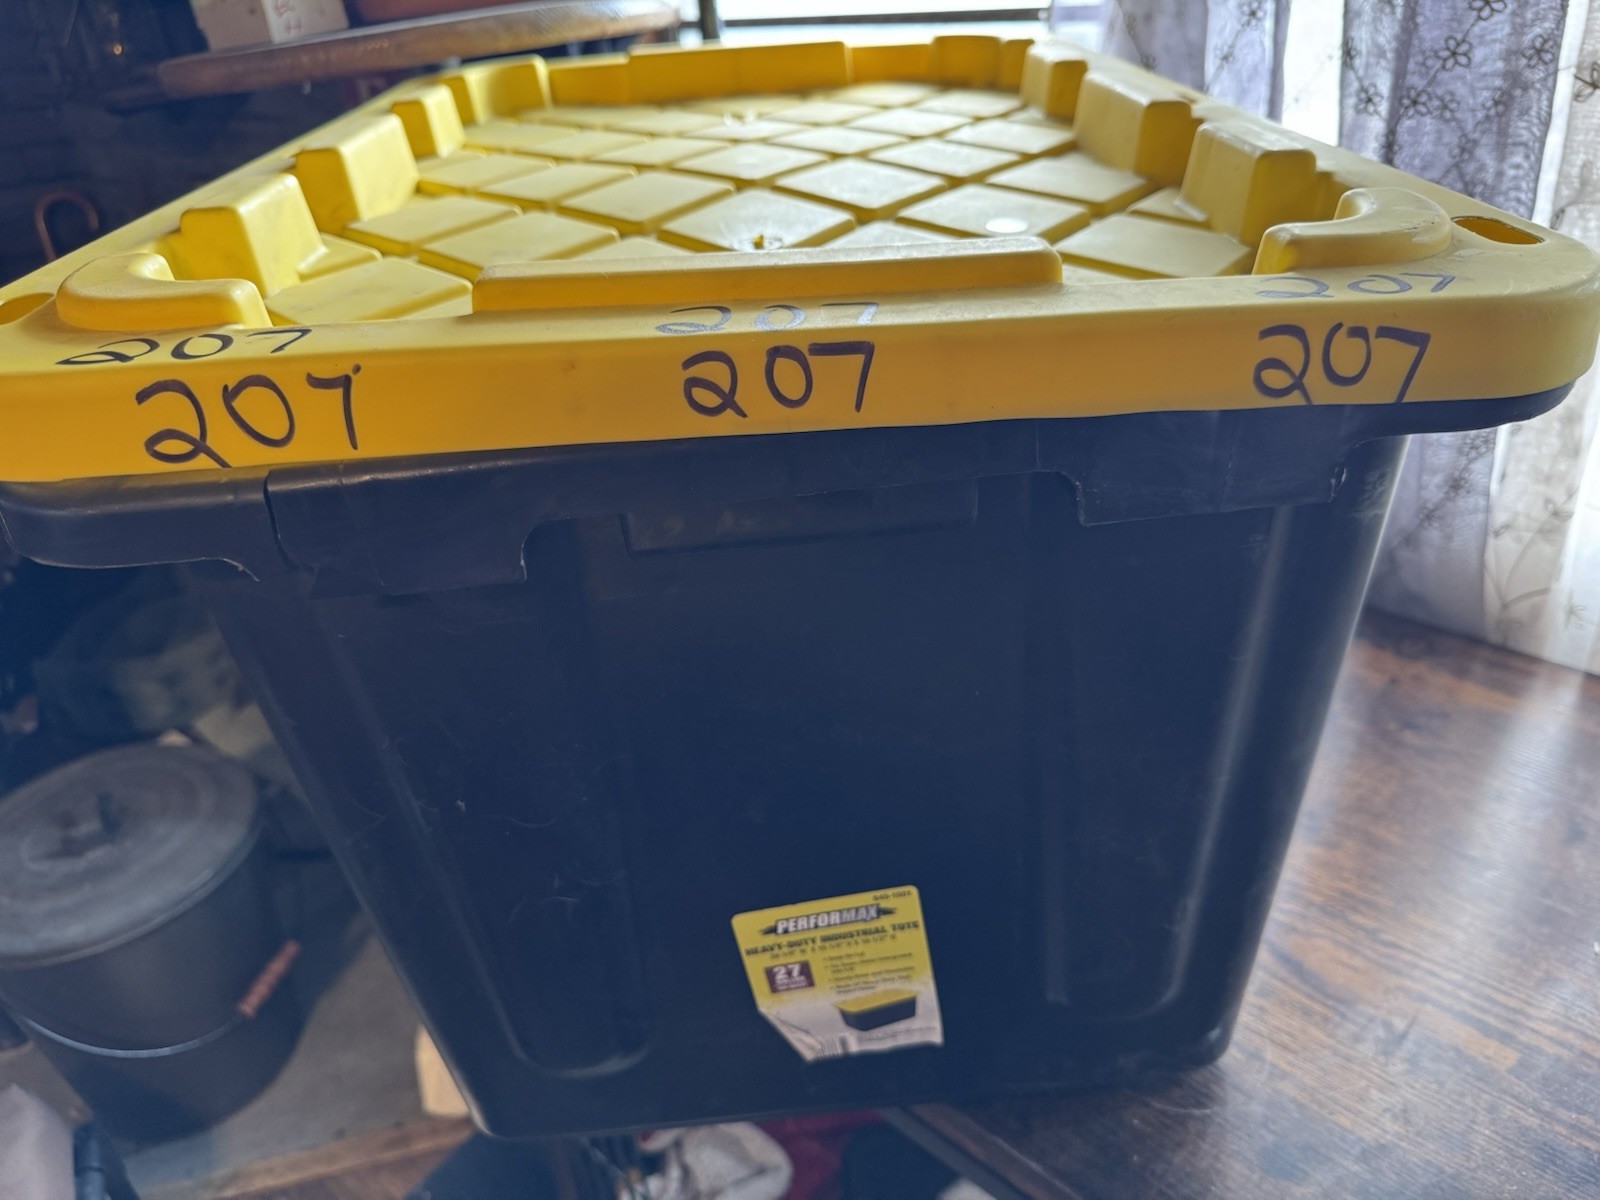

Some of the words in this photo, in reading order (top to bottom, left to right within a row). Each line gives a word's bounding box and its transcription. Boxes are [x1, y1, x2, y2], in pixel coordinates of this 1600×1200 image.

[1253, 272, 1456, 299] 207
[655, 302, 880, 334] 207
[55, 327, 312, 366] 207
[1252, 321, 1431, 405] 207
[681, 340, 875, 418] 207
[135, 363, 362, 468] 207
[775, 904, 880, 934] PERFORMAX
[744, 935, 818, 956] HEAVY-DUTY
[820, 926, 887, 943] INDUSTRIAL
[890, 920, 919, 932] TOTE
[772, 963, 802, 978] 27
